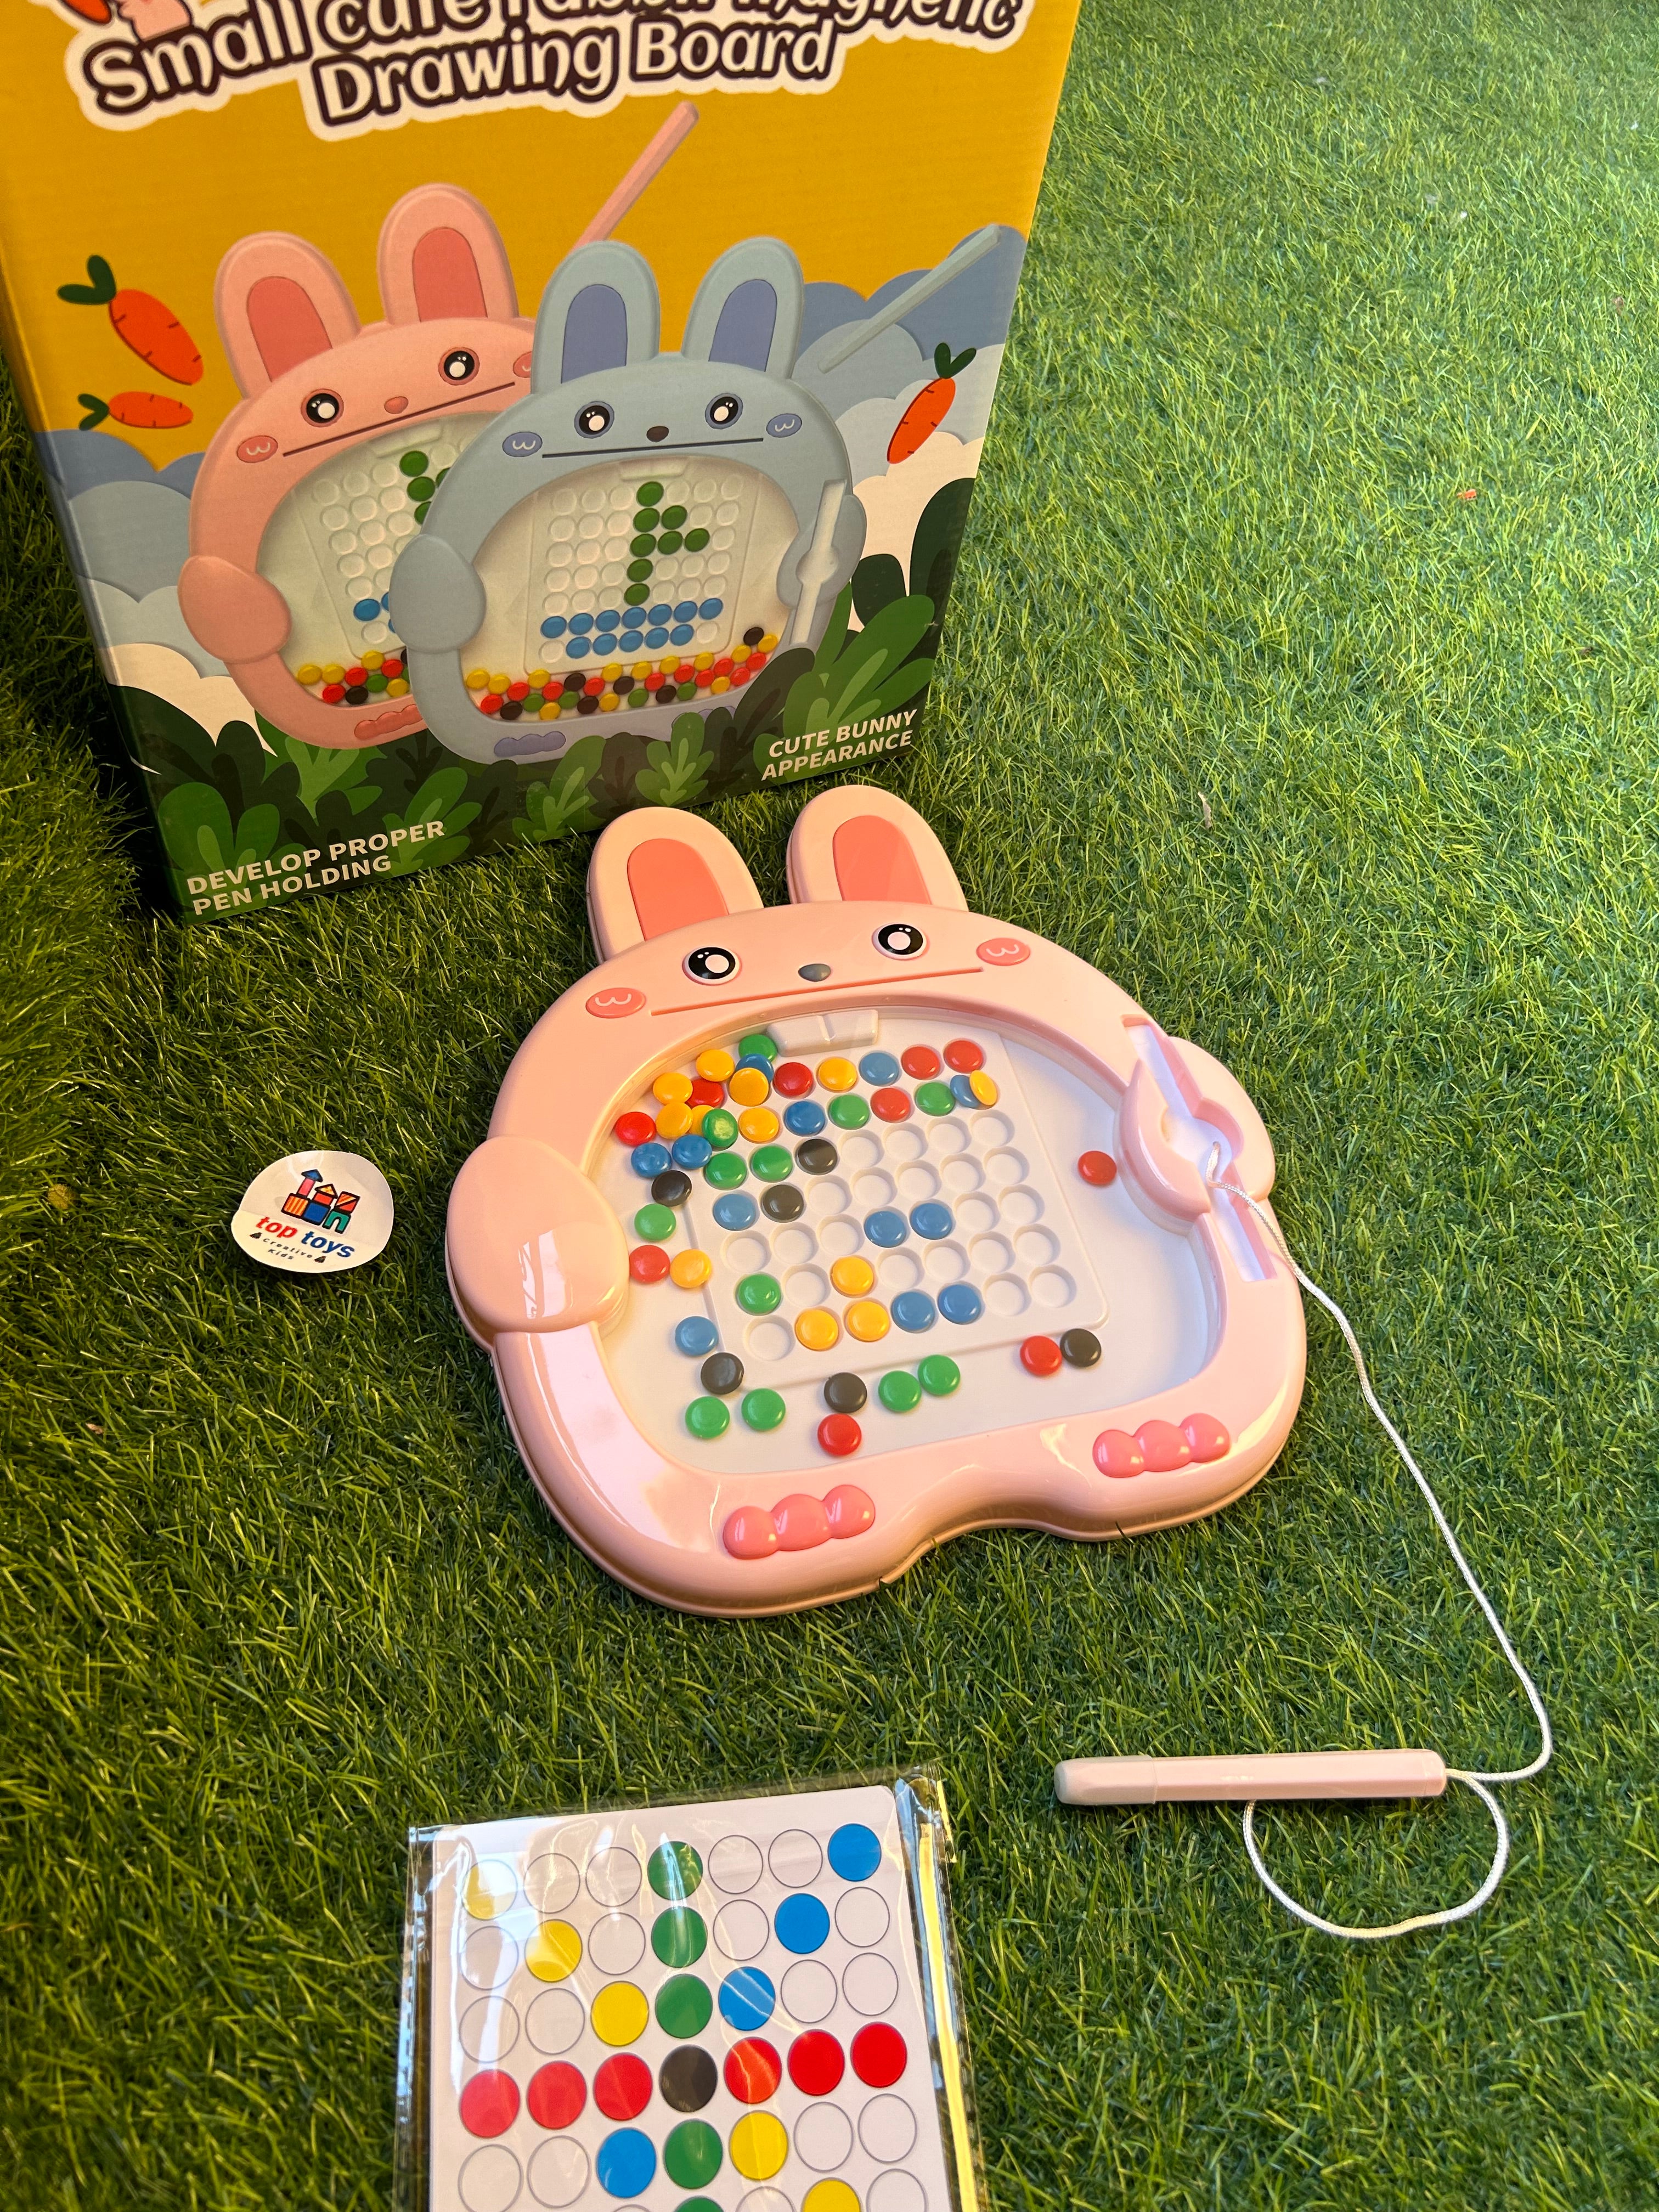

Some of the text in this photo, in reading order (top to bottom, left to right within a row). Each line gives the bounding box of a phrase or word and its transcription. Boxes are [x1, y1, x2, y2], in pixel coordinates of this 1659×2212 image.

[88, 0, 308, 109] Small
[315, 18, 834, 122] Drawing Board
[761, 729, 913, 781] APPEARANCE
[769, 709, 918, 758] CUTE BUNNY
[187, 821, 445, 895] DEVELOP PROPER
[192, 855, 392, 916] PEN HOLDING
[256, 1216, 355, 1258] top toys
